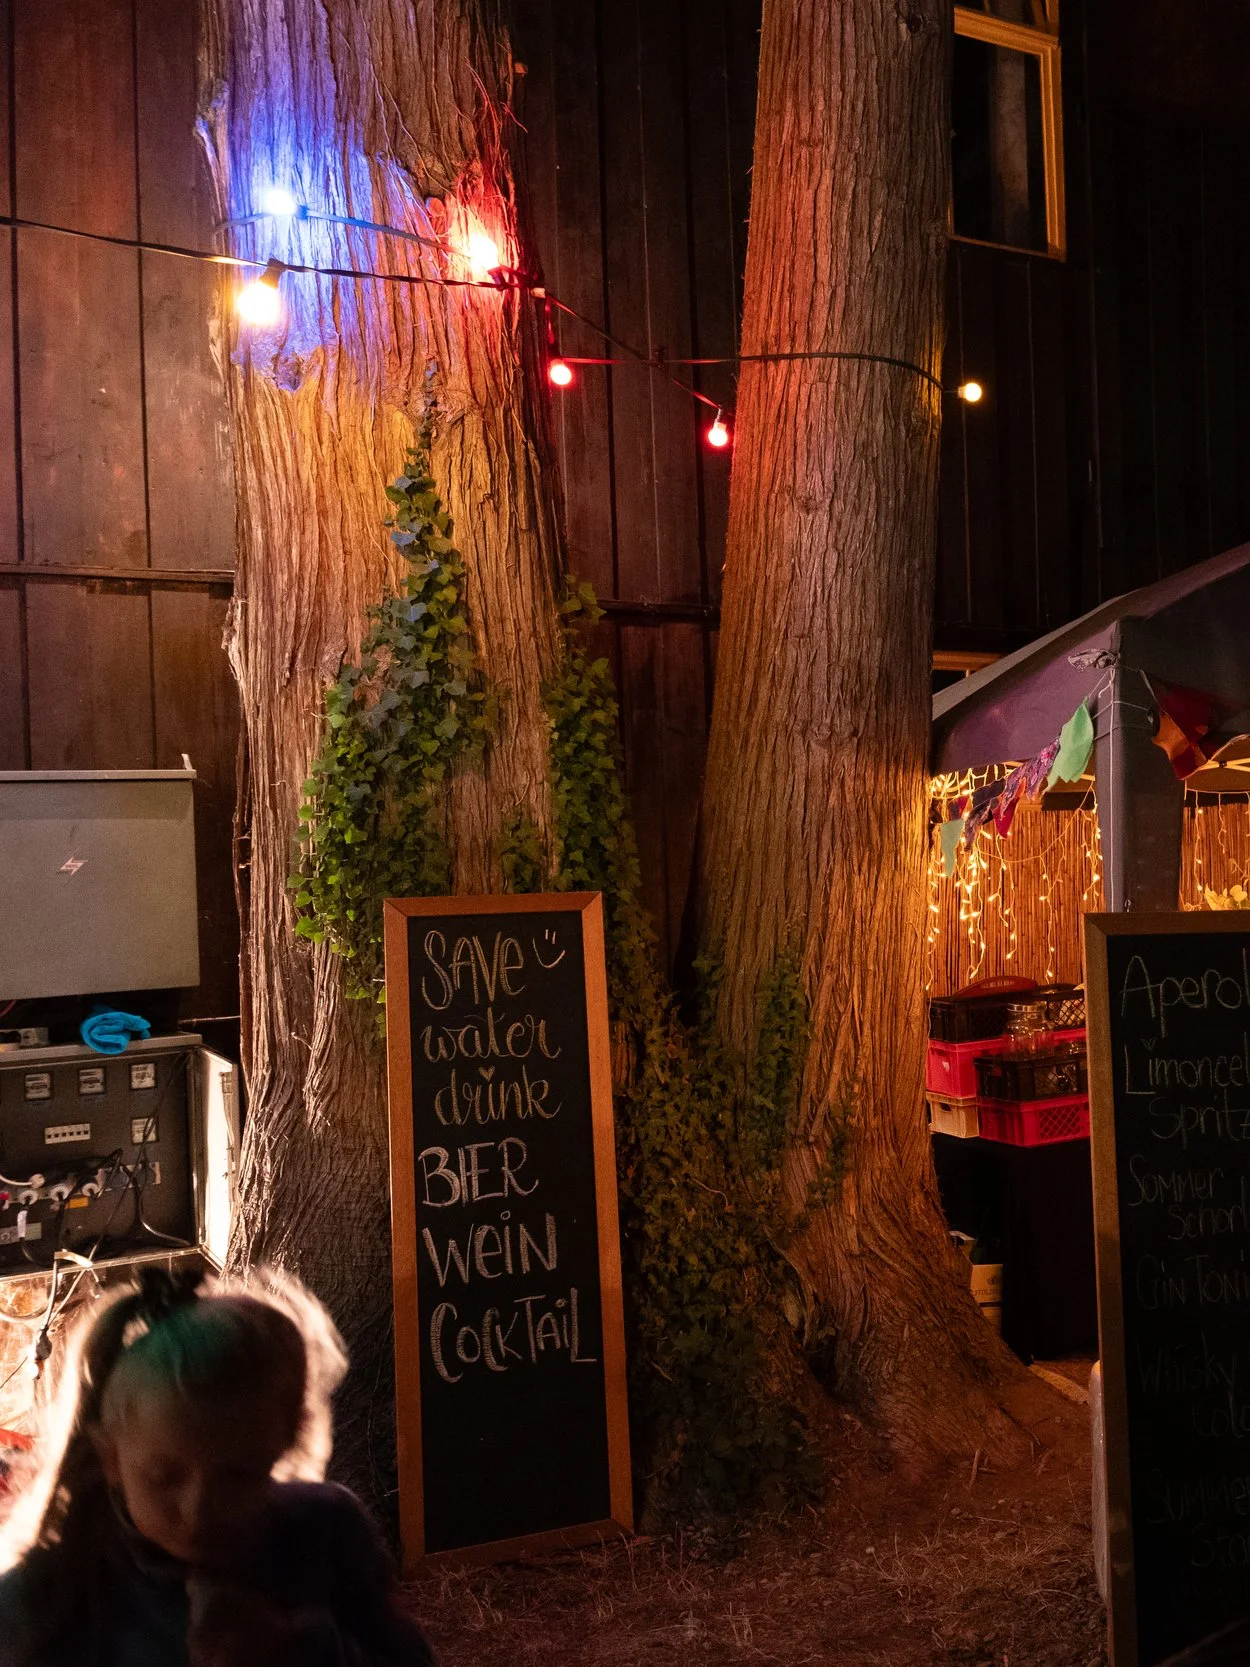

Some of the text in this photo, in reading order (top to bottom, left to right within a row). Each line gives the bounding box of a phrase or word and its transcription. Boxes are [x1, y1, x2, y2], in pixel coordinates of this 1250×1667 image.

[420, 1006, 562, 1063] water
[434, 1064, 562, 1126] drink
[418, 1136, 540, 1208] BIER
